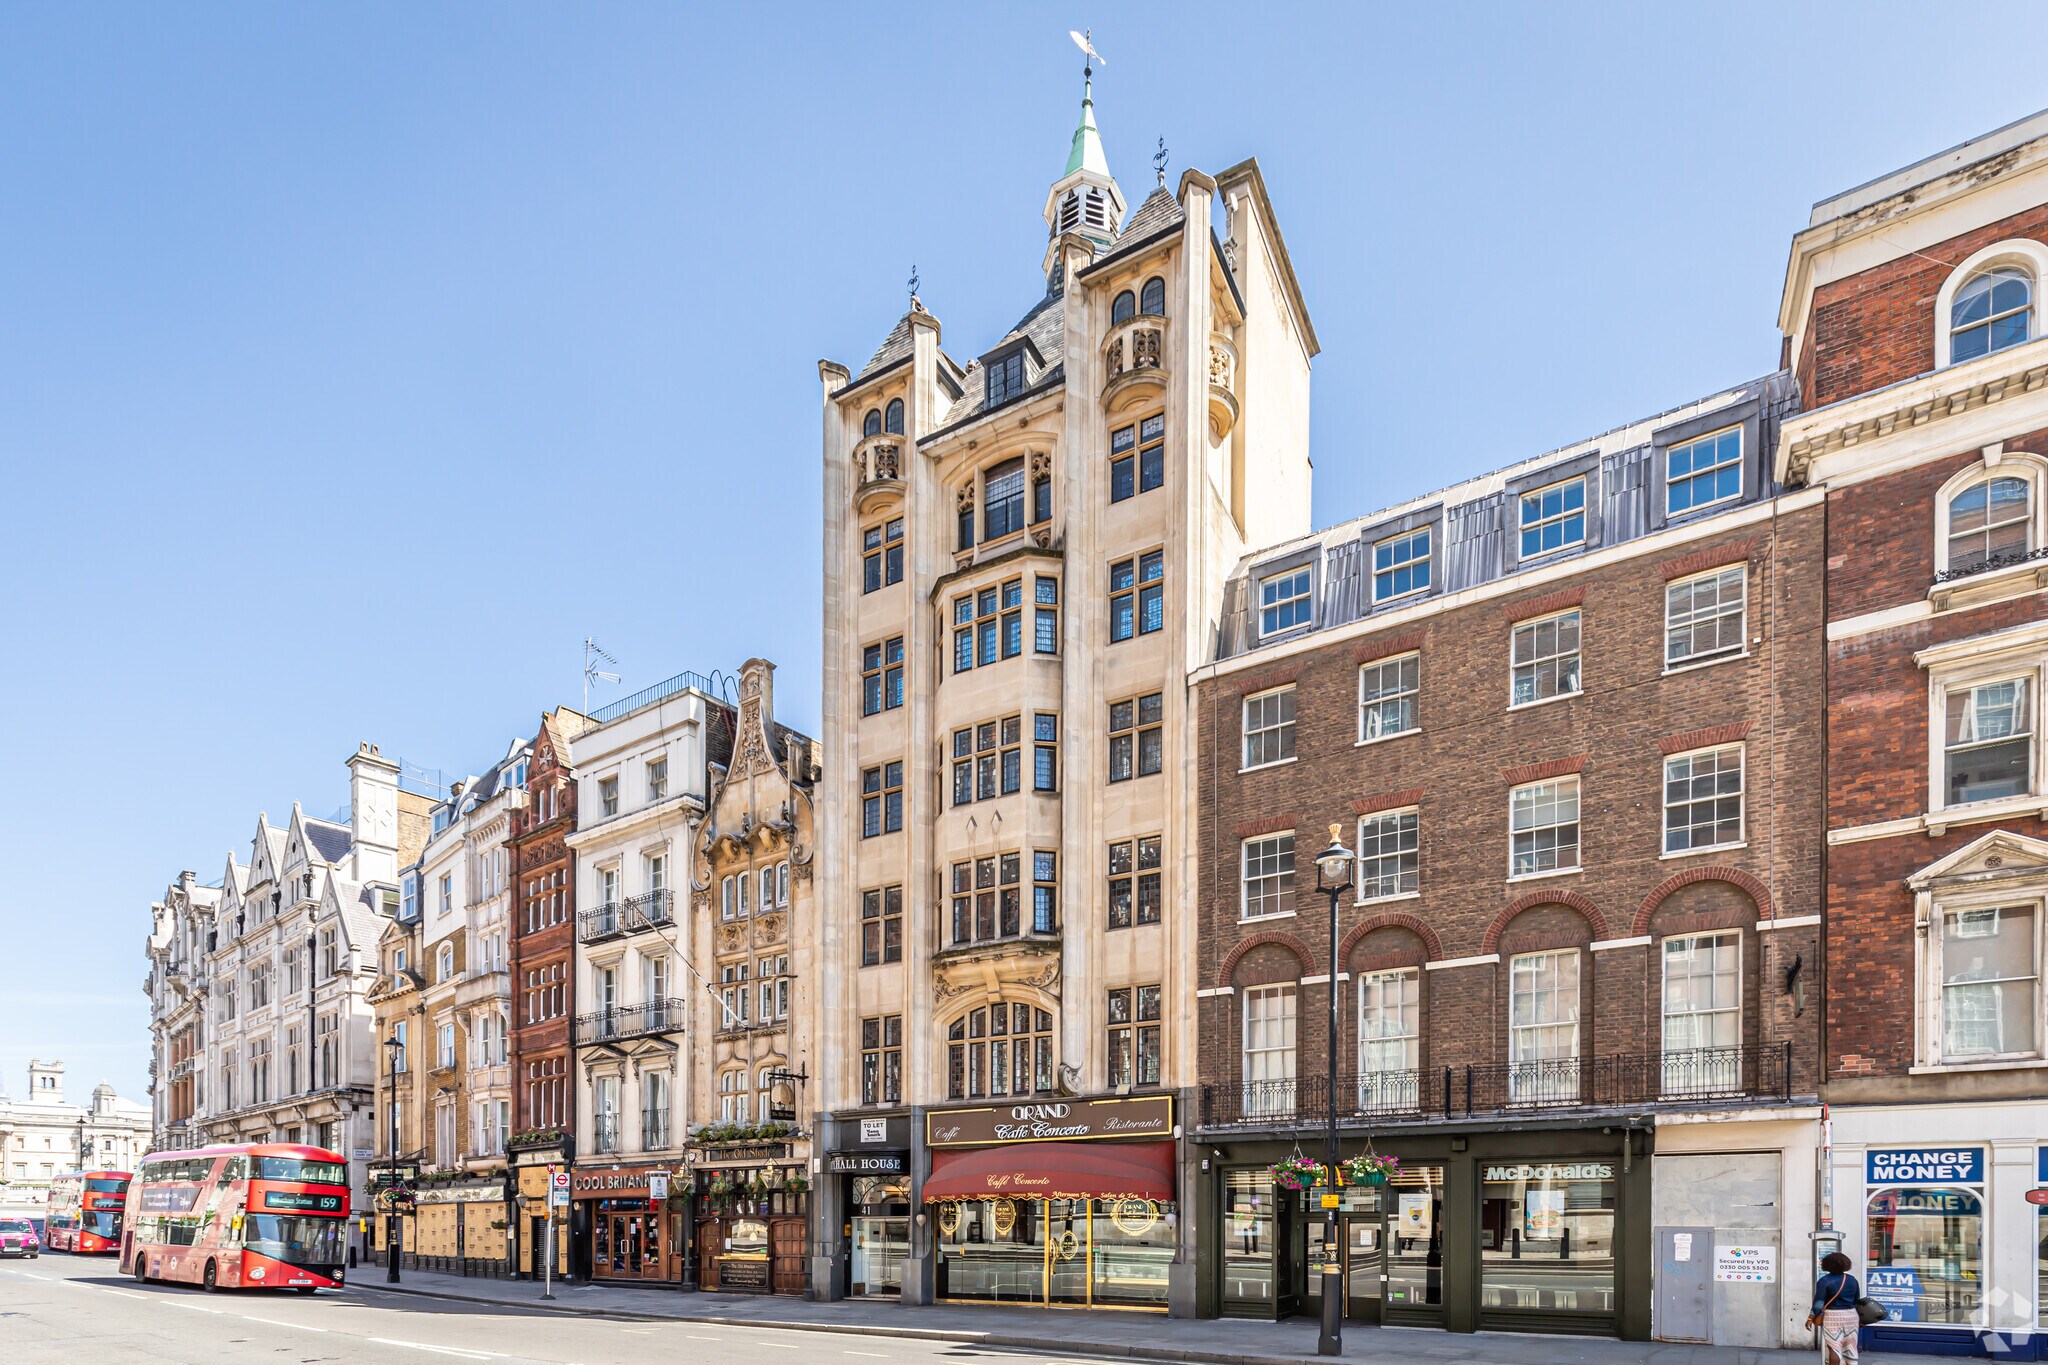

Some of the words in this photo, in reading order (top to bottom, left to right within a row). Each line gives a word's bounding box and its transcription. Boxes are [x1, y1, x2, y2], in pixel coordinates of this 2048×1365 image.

[1012, 1103, 1071, 1123] GRAND
[1031, 1121, 1090, 1138] Concerto
[1103, 1117, 1163, 1131] Ristorante
[734, 1148, 746, 1159] Old
[1874, 1152, 1973, 1165] CHANGE
[861, 1159, 901, 1169] HOUSE
[1013, 1173, 1050, 1185] Concerto
[1485, 1164, 1612, 1180] McDonald's
[1873, 1165, 1973, 1179] MONEY
[574, 1176, 605, 1190] COOL
[320, 1197, 337, 1208] 159
[1887, 1195, 1974, 1210] MONEY
[861, 1206, 871, 1215] 41
[1868, 1272, 1913, 1286] ATM
